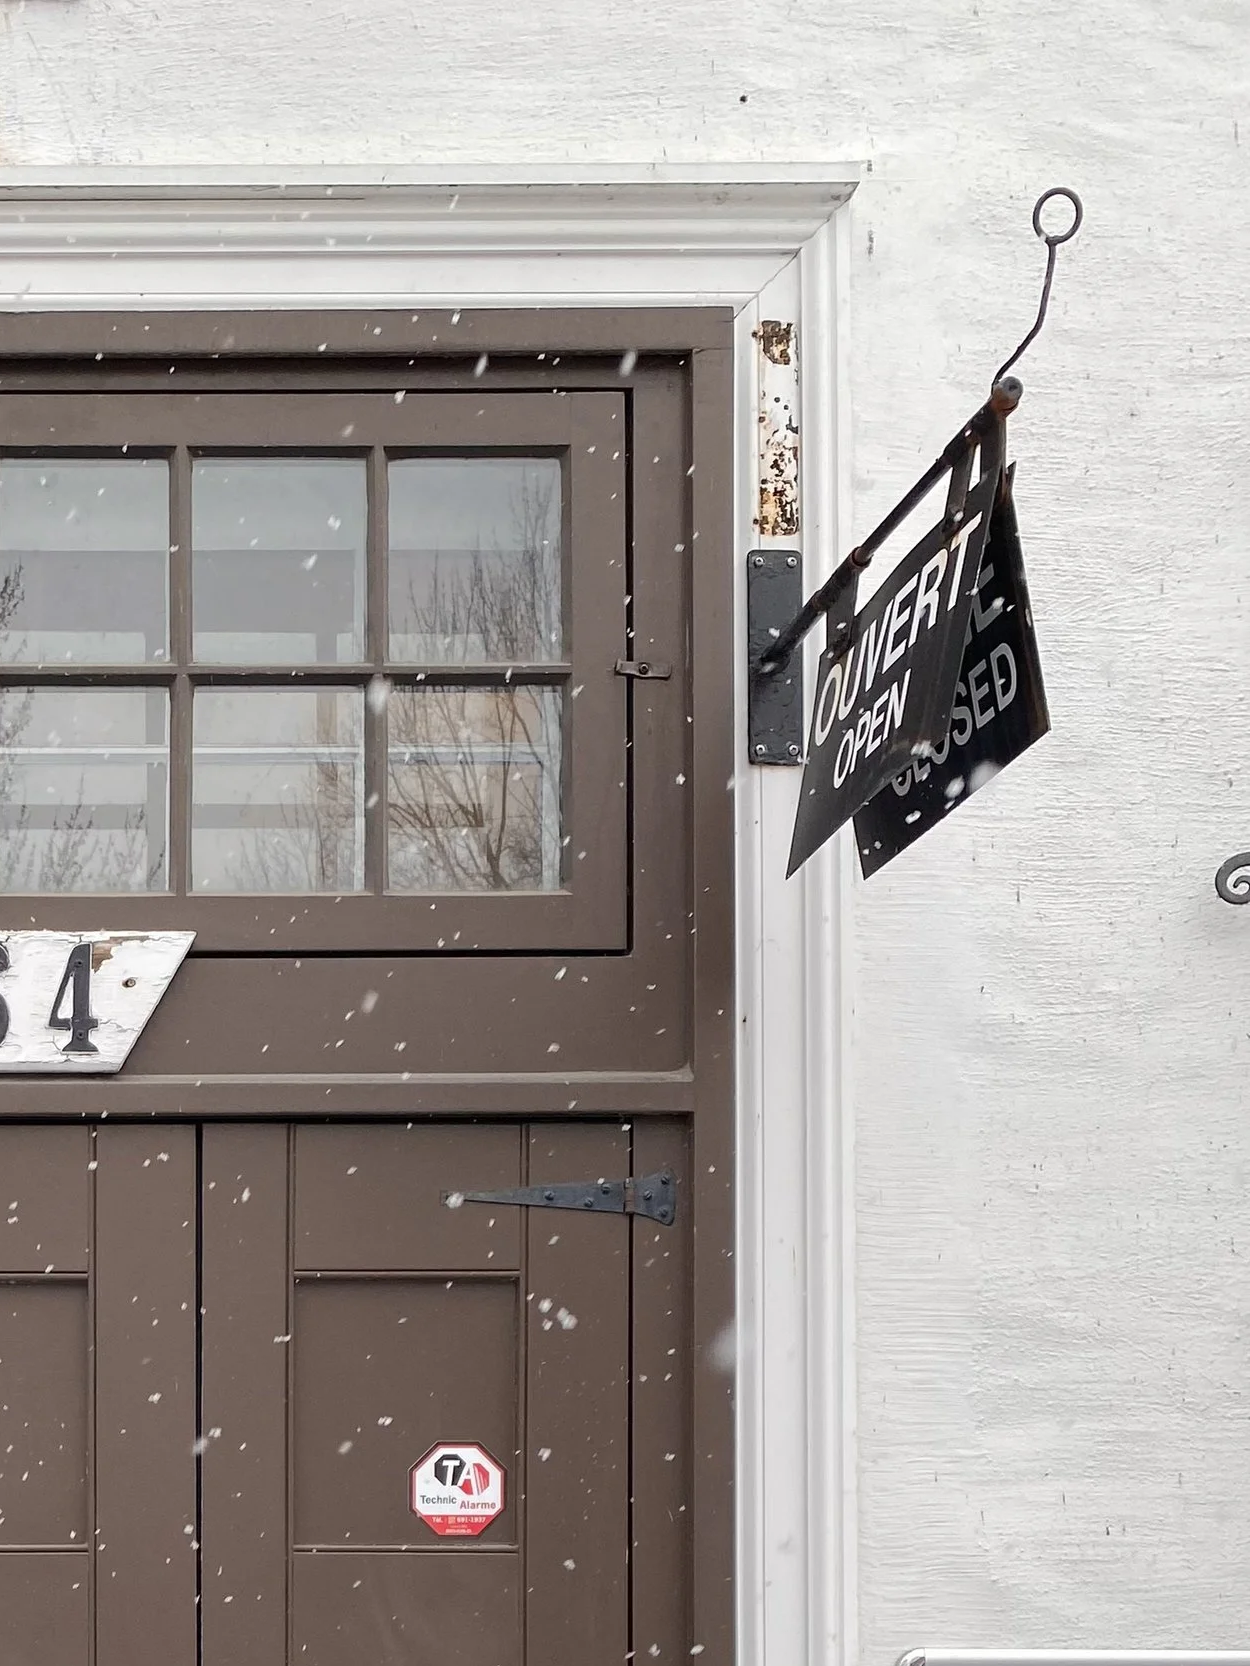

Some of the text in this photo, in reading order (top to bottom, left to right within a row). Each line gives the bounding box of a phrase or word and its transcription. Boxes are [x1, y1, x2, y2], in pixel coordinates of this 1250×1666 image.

[814, 510, 983, 747] OUVERT
[833, 667, 912, 789] OPEN
[420, 1495, 497, 1510] Technic Alarme
